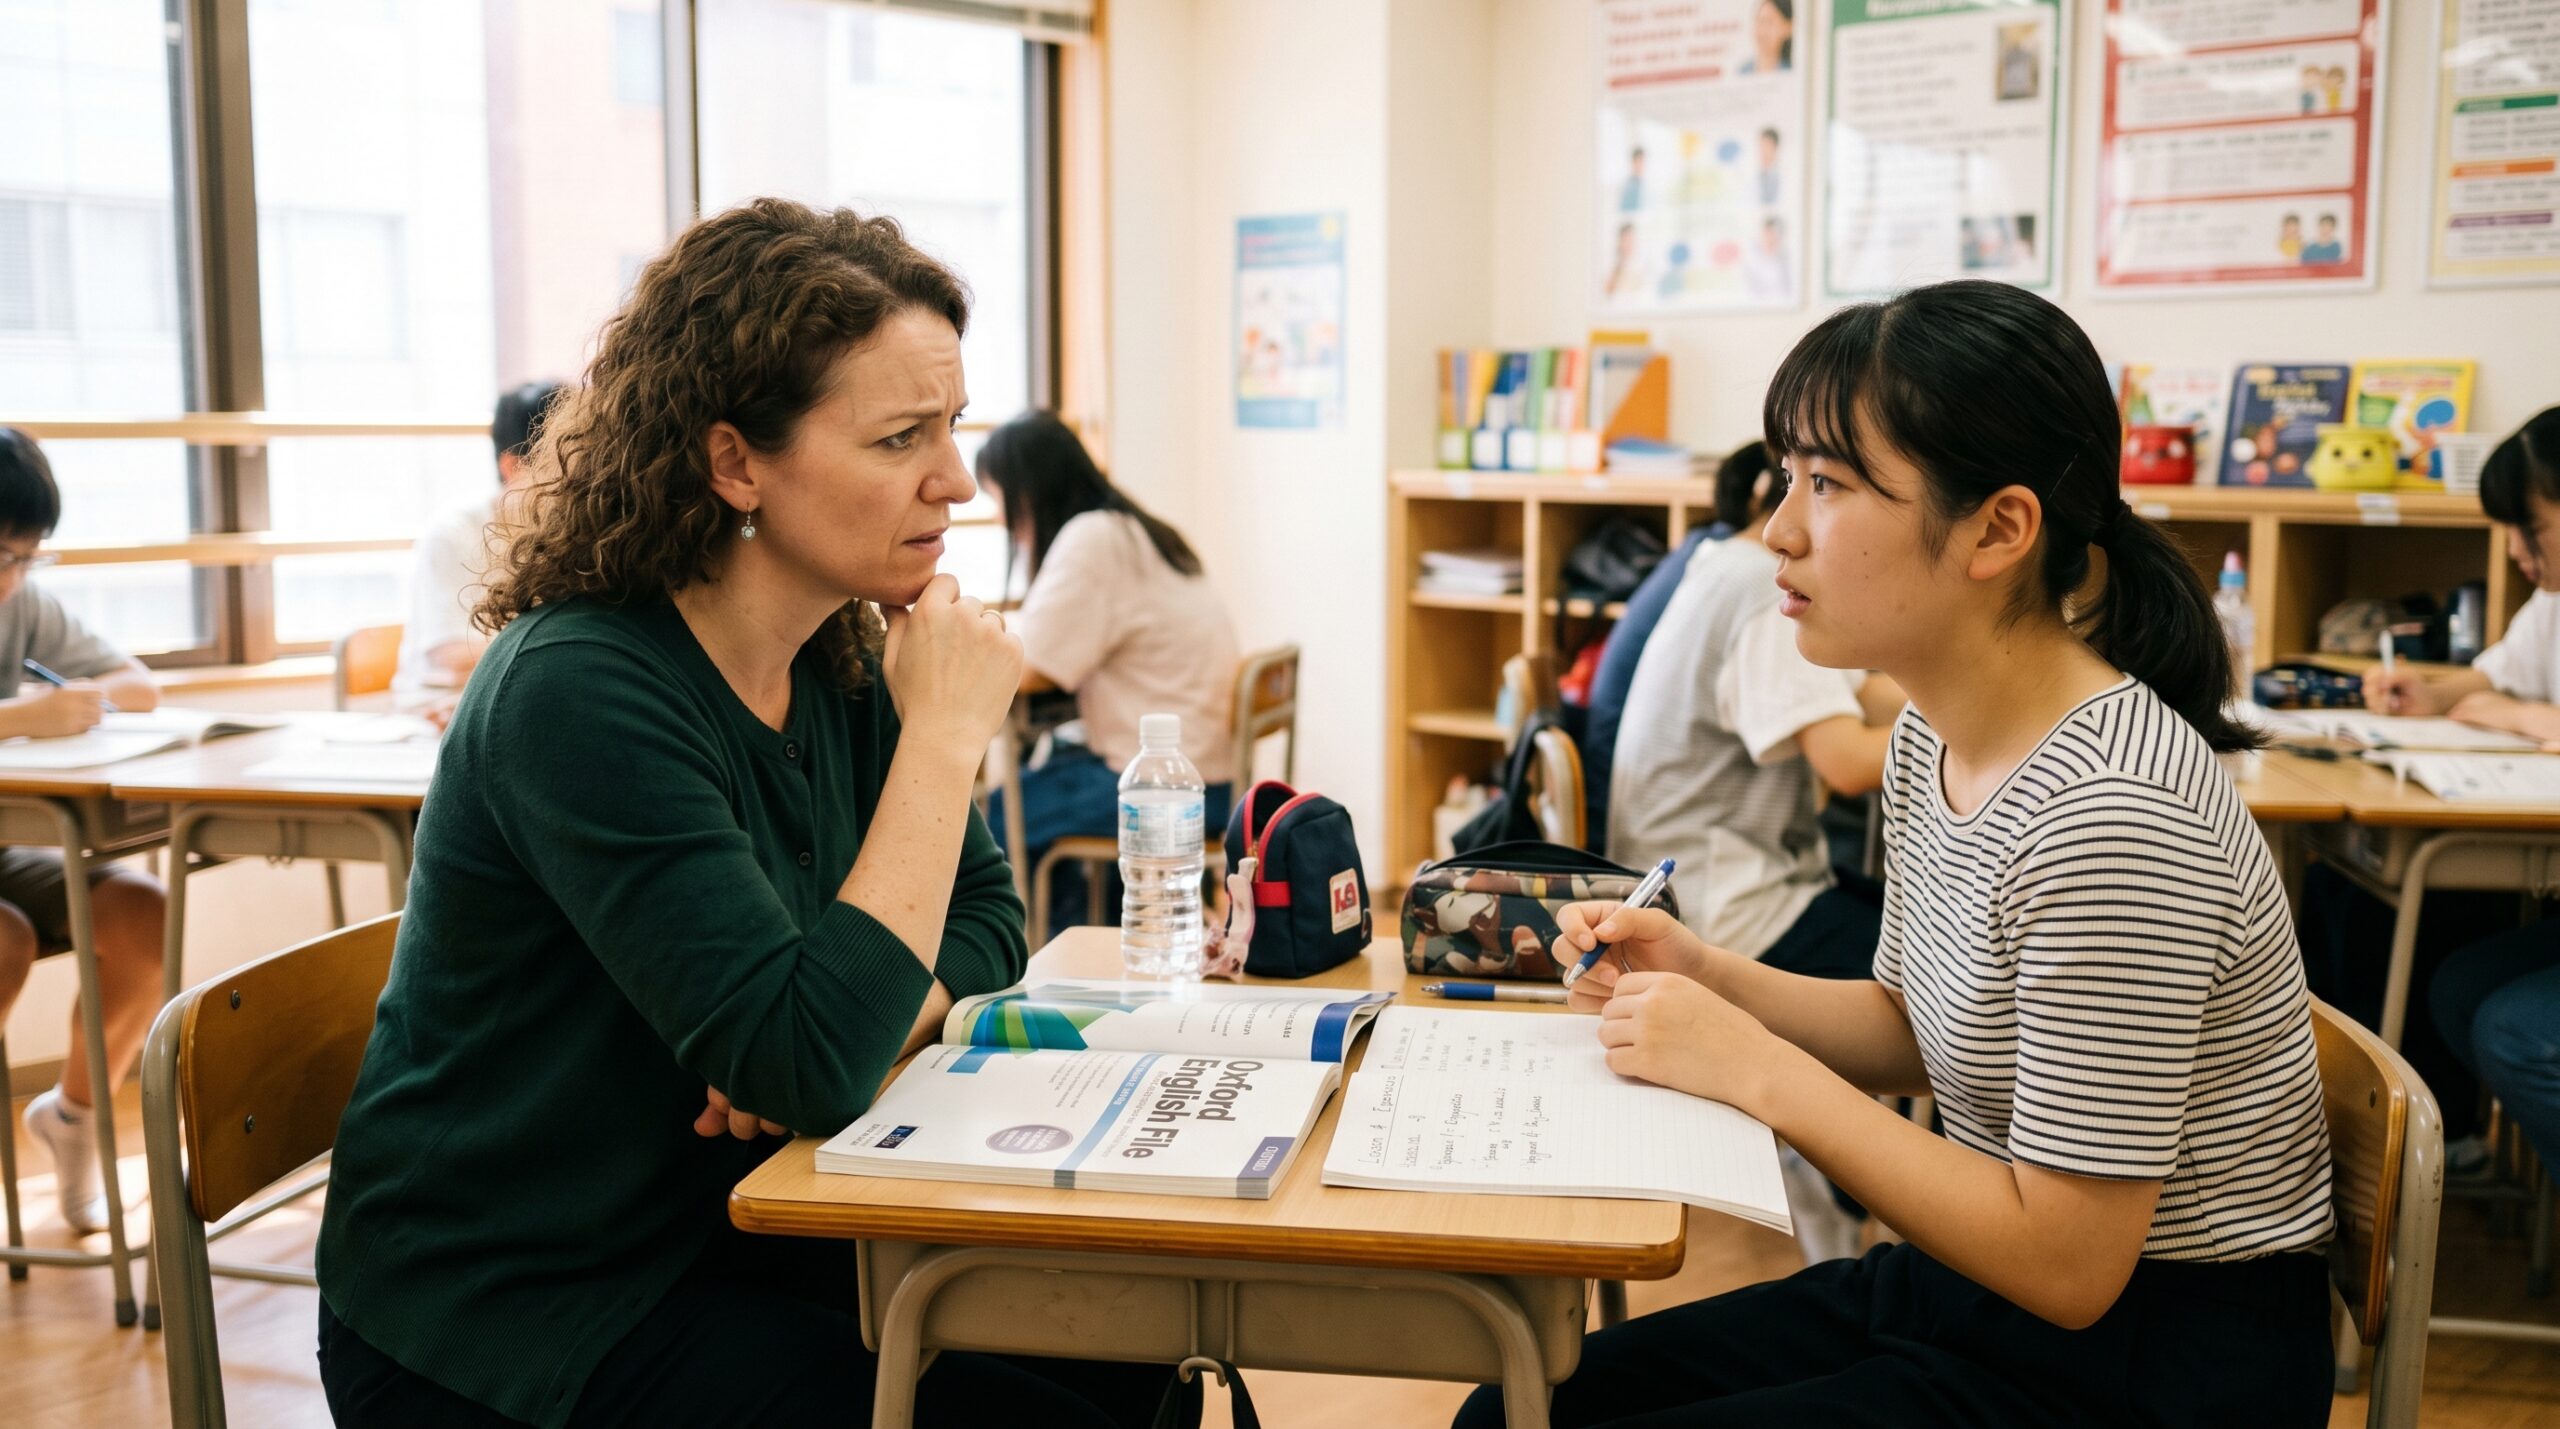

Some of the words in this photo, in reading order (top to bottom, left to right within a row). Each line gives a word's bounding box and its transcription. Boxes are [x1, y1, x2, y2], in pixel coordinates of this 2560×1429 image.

[1146, 1059, 1221, 1122] English
[1196, 1060, 1264, 1121] Oxford
[1122, 1127, 1180, 1159] File
